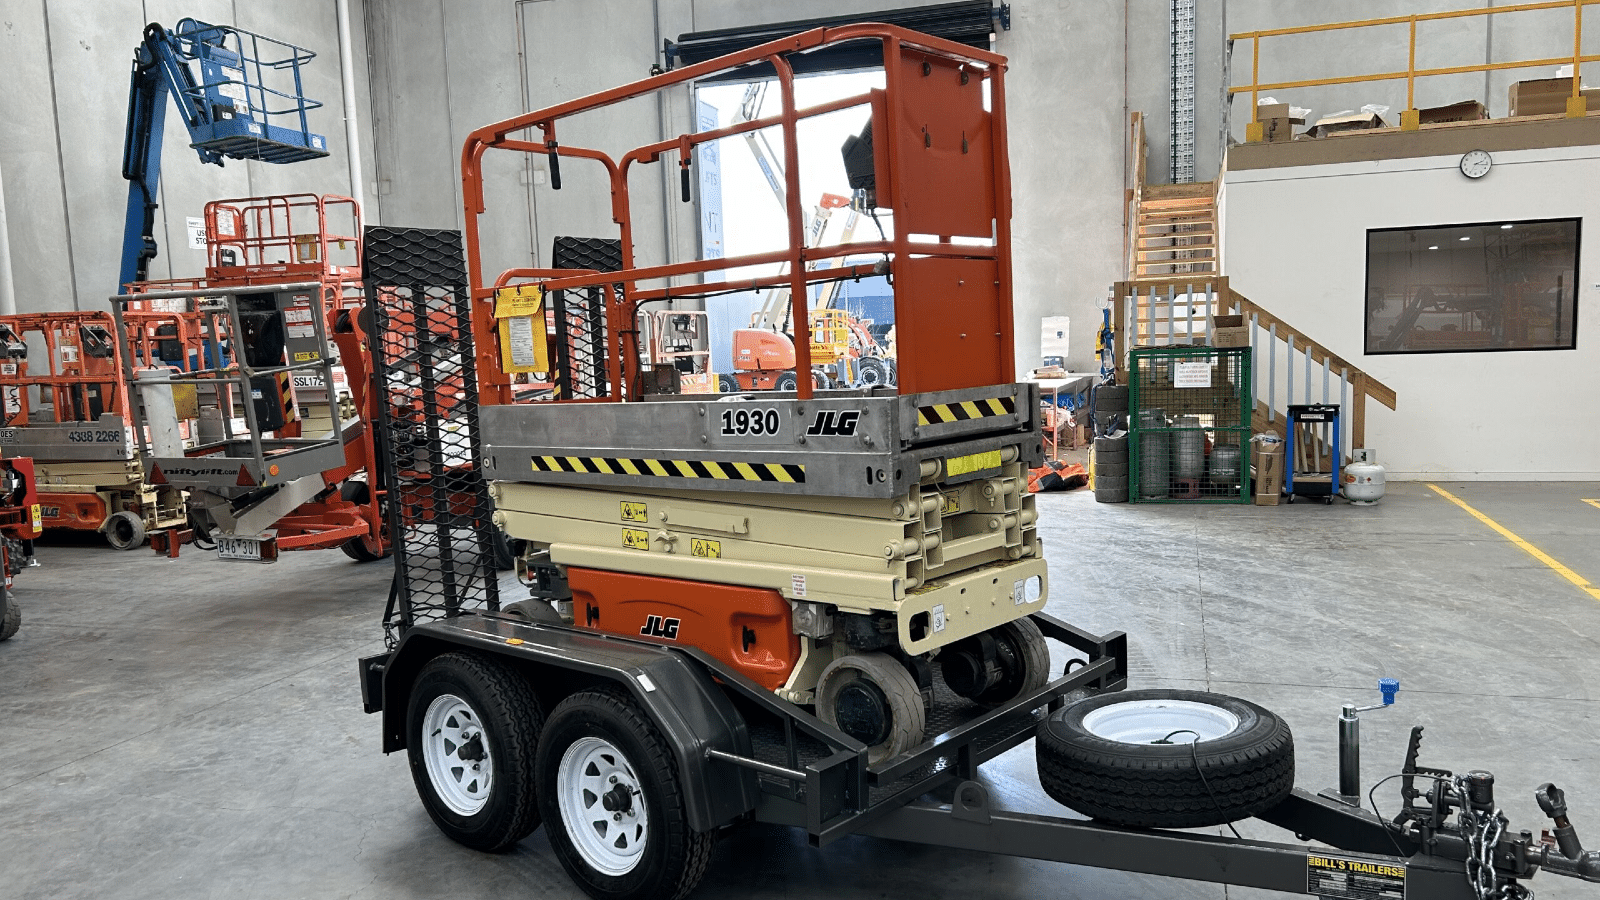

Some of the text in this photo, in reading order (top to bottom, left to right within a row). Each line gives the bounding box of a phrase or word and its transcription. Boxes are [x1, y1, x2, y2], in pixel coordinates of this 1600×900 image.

[721, 408, 780, 436] 1930
[806, 410, 861, 437] JLG
[96, 431, 119, 442] 2266
[163, 468, 238, 477] niftylift.com
[242, 541, 258, 555] 301
[640, 614, 681, 640] JLG
[1314, 857, 1399, 877] BILL'S TRAILERS
